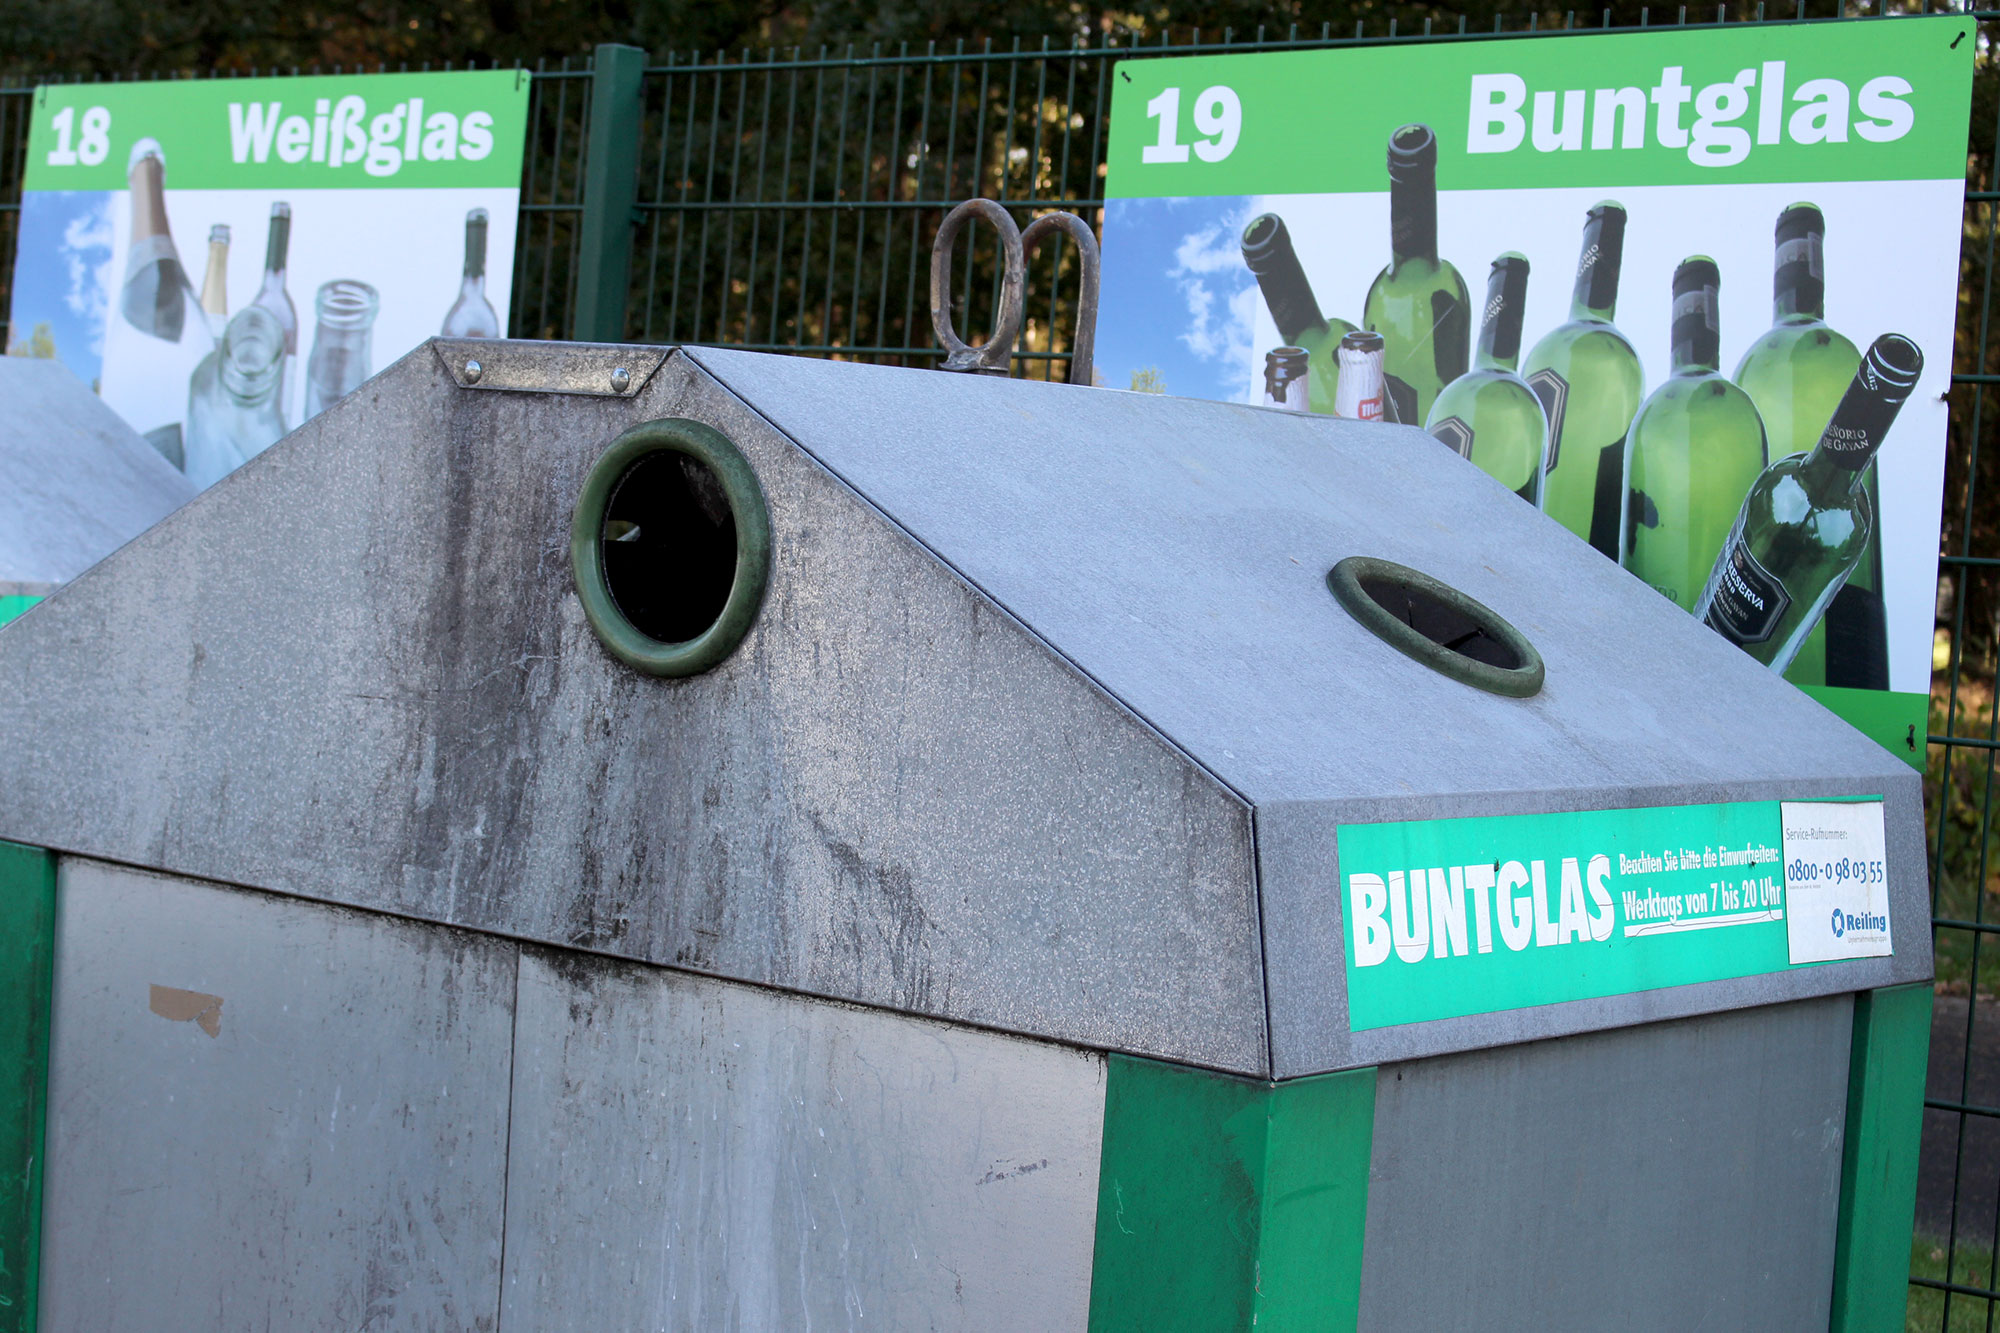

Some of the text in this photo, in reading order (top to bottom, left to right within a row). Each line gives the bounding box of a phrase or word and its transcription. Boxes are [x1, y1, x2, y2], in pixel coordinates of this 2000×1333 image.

[47, 95, 494, 177] 18 Weißglas
[1141, 60, 1915, 168] 19 Buntglas
[1727, 559, 1765, 611] RESERVA
[1619, 842, 1779, 875] Beachten Sie bitte die Einwurfzeiten:
[1785, 827, 1848, 841] Service-Rufnummer:
[1835, 857, 1850, 885] 98
[1349, 853, 1615, 968] BUNTGLAS
[1622, 876, 1782, 925] Werktags von 7 bis 20 Uhr
[1846, 911, 1887, 933] Reiling
